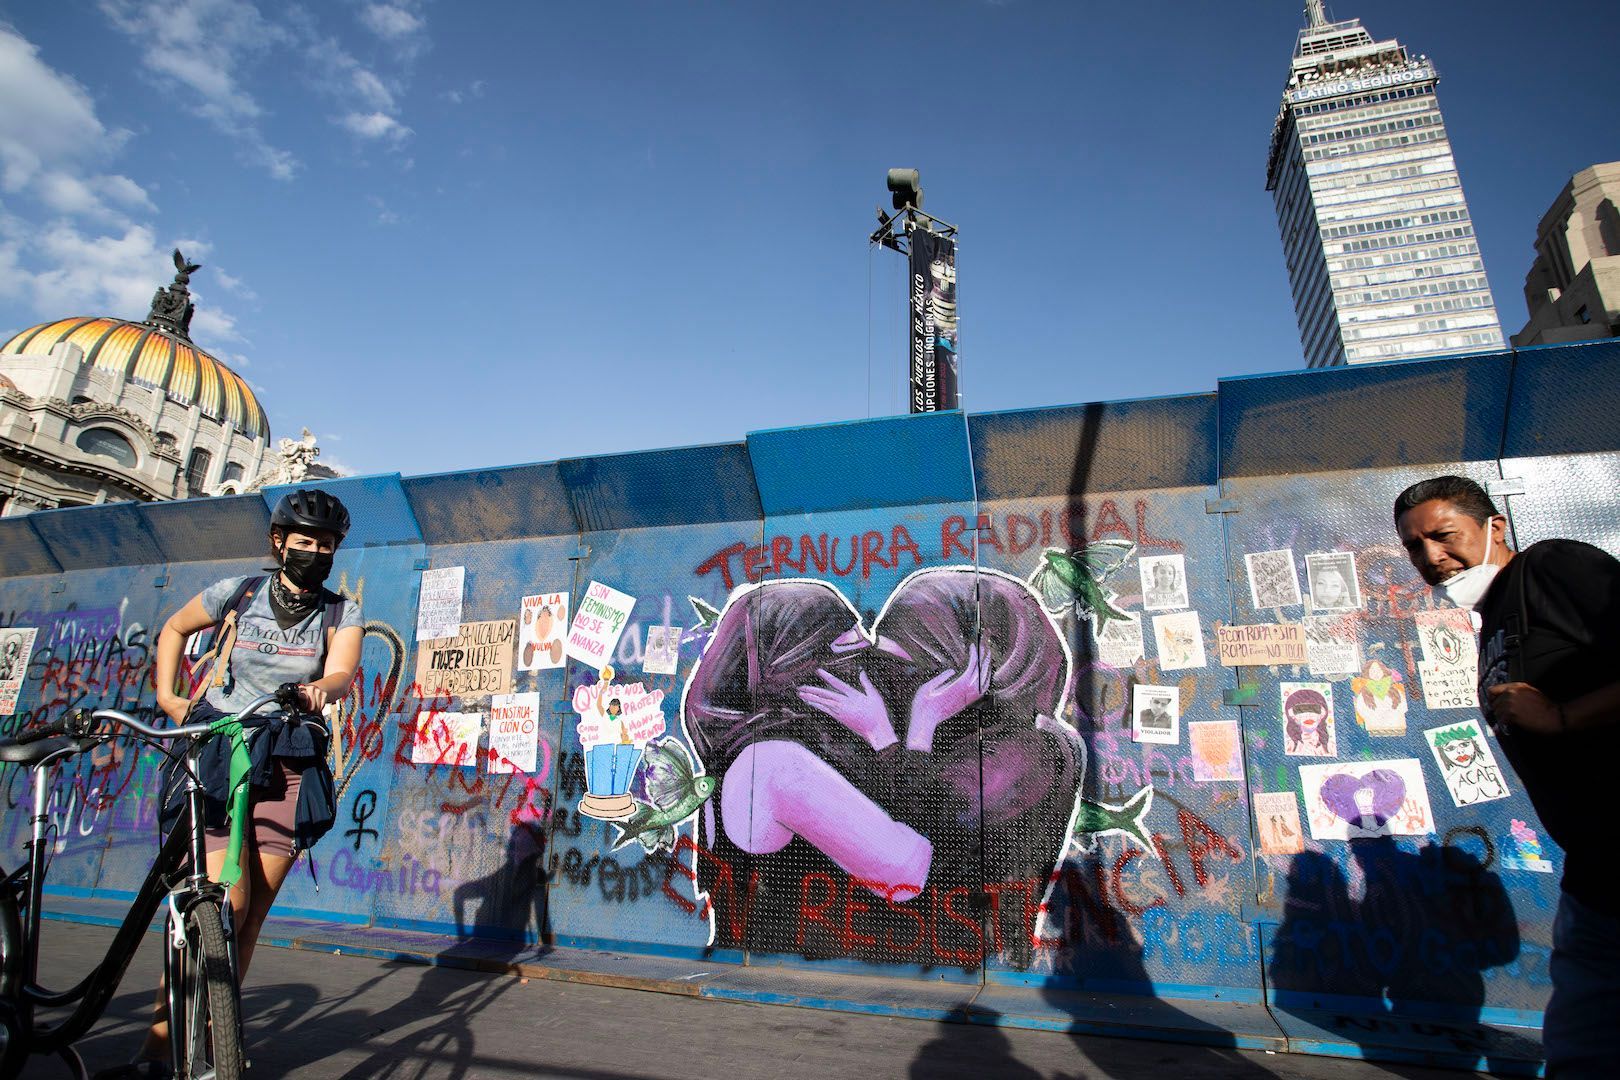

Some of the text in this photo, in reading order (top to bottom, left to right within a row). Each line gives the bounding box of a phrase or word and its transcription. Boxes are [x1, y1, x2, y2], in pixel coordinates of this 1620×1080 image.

[1298, 69, 1424, 99] LATINO SEGUROS
[913, 273, 924, 412] LOS PUEBLOS DE MÉXICO
[694, 500, 1184, 591] TERNURA RADICAL
[523, 594, 561, 608] VIVA LA
[590, 584, 609, 599] SIN
[581, 597, 626, 624] FEMINISMO
[575, 614, 605, 635] NO SE
[1245, 626, 1272, 641] ROPA
[530, 642, 553, 652] VULVA
[570, 633, 605, 656] AVANZA
[431, 644, 503, 671] MUJER FUERTE
[1440, 665, 1477, 678] sangre
[505, 694, 515, 705] LA
[607, 685, 621, 697] SE
[624, 682, 644, 697] NOS
[1141, 728, 1171, 736] VIOLADOR
[1458, 767, 1497, 788] ACAB
[328, 847, 441, 896] Camila
[661, 835, 758, 942] EN
[799, 808, 1240, 965] RESISTENCIA
